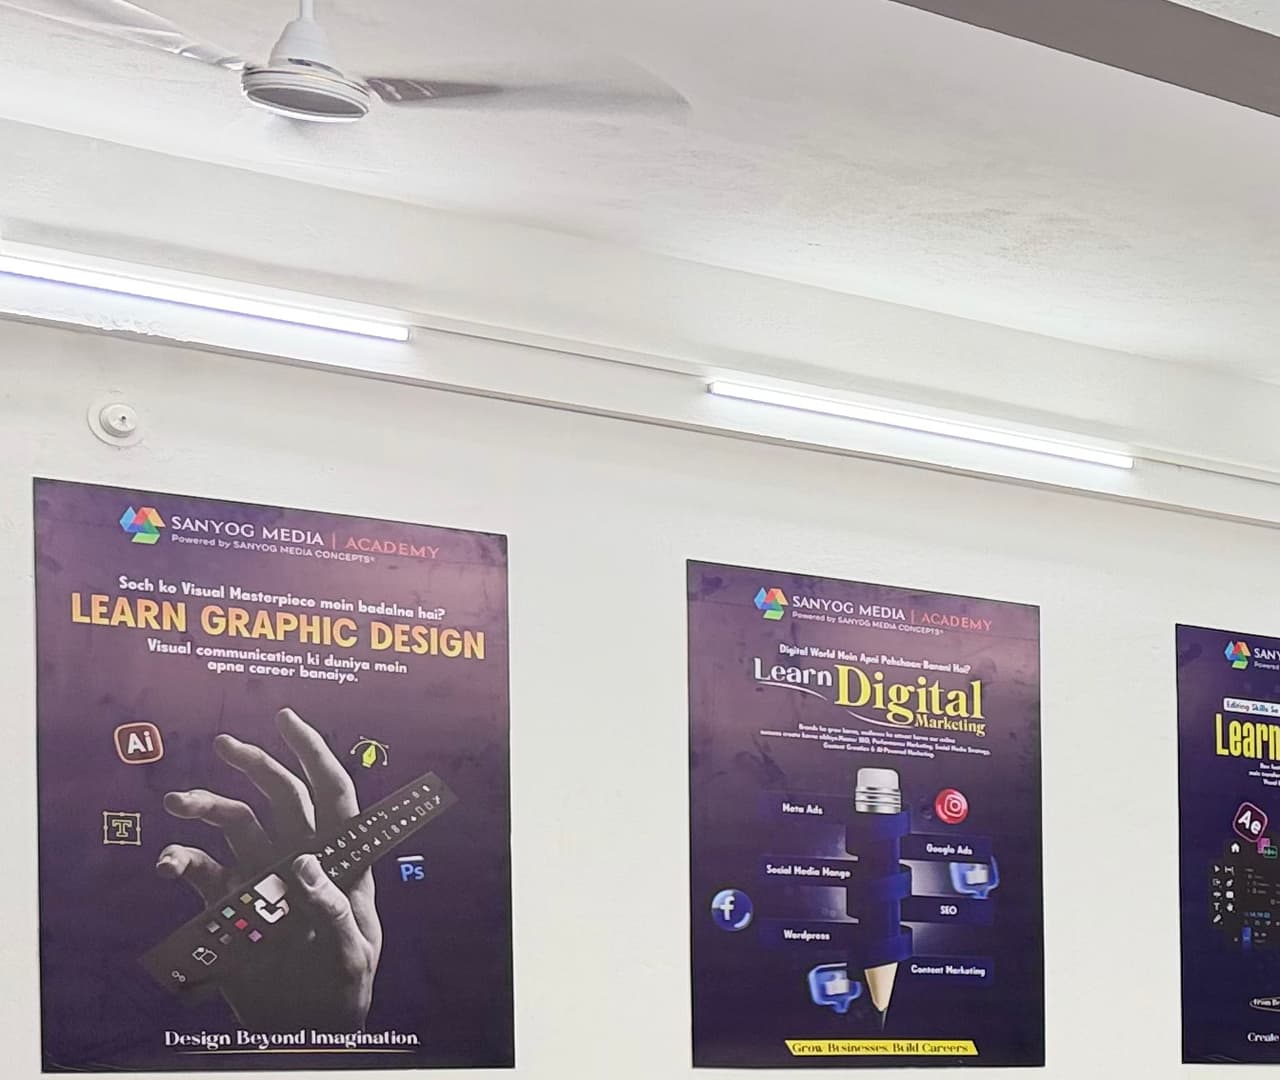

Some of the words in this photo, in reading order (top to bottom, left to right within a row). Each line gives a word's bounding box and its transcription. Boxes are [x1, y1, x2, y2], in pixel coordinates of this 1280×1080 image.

[171, 516, 255, 538] SANYOG
[262, 526, 325, 546] MEDIA
[345, 536, 440, 559] ACADEMY
[171, 534, 216, 547] Powered
[218, 538, 231, 549] by
[232, 541, 278, 553] SANYOG
[279, 545, 313, 557] MEDIA
[119, 575, 154, 592] Soch
[159, 579, 177, 594] ko
[181, 582, 225, 598] Visual
[229, 586, 316, 608] Masterpiece
[320, 598, 354, 612] mein
[358, 599, 414, 618] badalna
[418, 606, 446, 621] hai?
[792, 595, 854, 614] SANYOG
[859, 605, 906, 621] MEDIA
[921, 612, 993, 631] ACADEMY
[792, 611, 825, 622] Powered
[827, 615, 836, 624] by
[838, 616, 871, 627] SANYOG
[872, 621, 897, 630] MEDIA
[71, 592, 187, 632] LEARN
[201, 604, 358, 648] GRAPHIC
[370, 621, 485, 660] DESIGN
[147, 638, 191, 655] Visual
[196, 646, 302, 664] communication
[307, 652, 320, 666] ki
[324, 654, 370, 673] duniya
[374, 661, 408, 673] mein
[779, 644, 808, 656] Digital
[810, 647, 836, 658] World
[207, 660, 244, 674] apna
[249, 663, 296, 677] career
[754, 657, 833, 686] Learn
[834, 664, 985, 726] Digital
[1226, 700, 1250, 711] Editing
[915, 713, 986, 737] Marketing
[126, 729, 155, 754] Ai
[782, 803, 803, 814] Meta
[807, 804, 823, 815] Ads
[1237, 810, 1262, 835] Ae
[927, 844, 954, 857] Google
[957, 845, 973, 856] Ads
[400, 863, 425, 882] Ps
[766, 864, 791, 876] Social
[794, 865, 819, 877] Media
[940, 905, 957, 916] SEO
[911, 965, 944, 975] Content
[946, 965, 986, 978] Marketing
[164, 1030, 231, 1048] Design
[236, 1030, 305, 1050] Beyond
